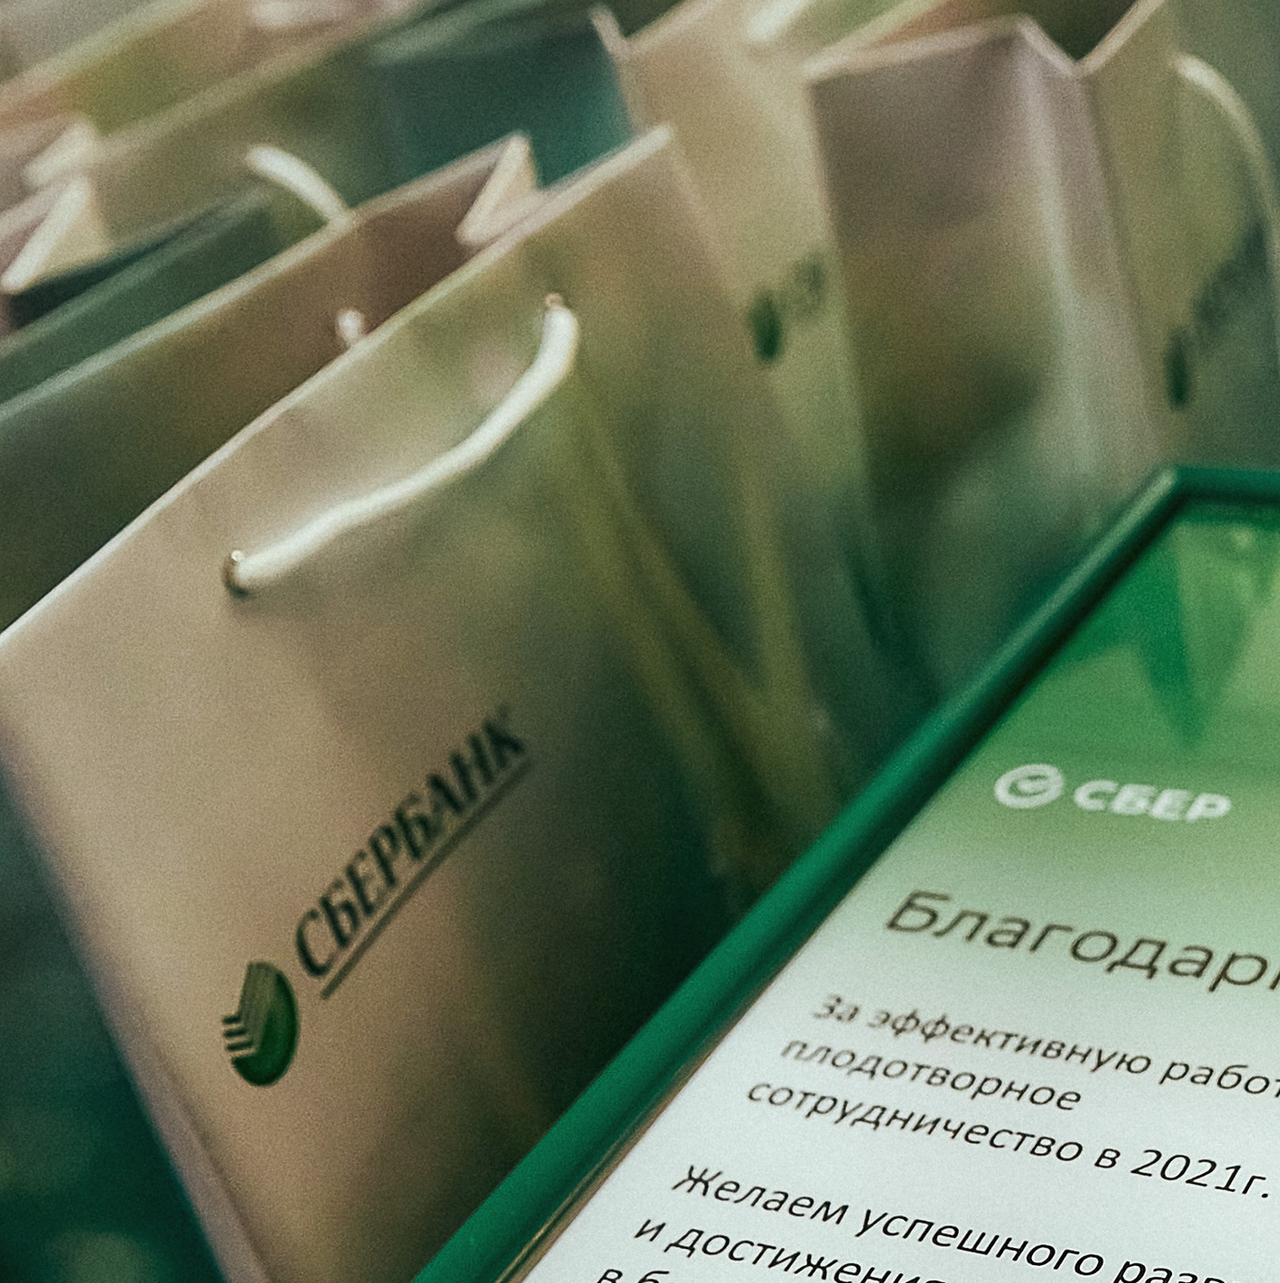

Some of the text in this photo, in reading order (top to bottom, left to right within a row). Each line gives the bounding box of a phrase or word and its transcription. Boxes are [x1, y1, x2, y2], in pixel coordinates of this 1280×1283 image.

[1074, 779, 1232, 823] СБЕР
[296, 706, 526, 977] СБЕРБАНК
[812, 994, 860, 1022] За
[867, 1008, 1151, 1073] эффективную
[780, 1039, 1082, 1111] плодотворное
[748, 1082, 1271, 1201] сотрудничество в 2021г.
[633, 1219, 667, 1242] и
[672, 1165, 849, 1225] Желаем
[855, 1209, 1103, 1278] успешного
